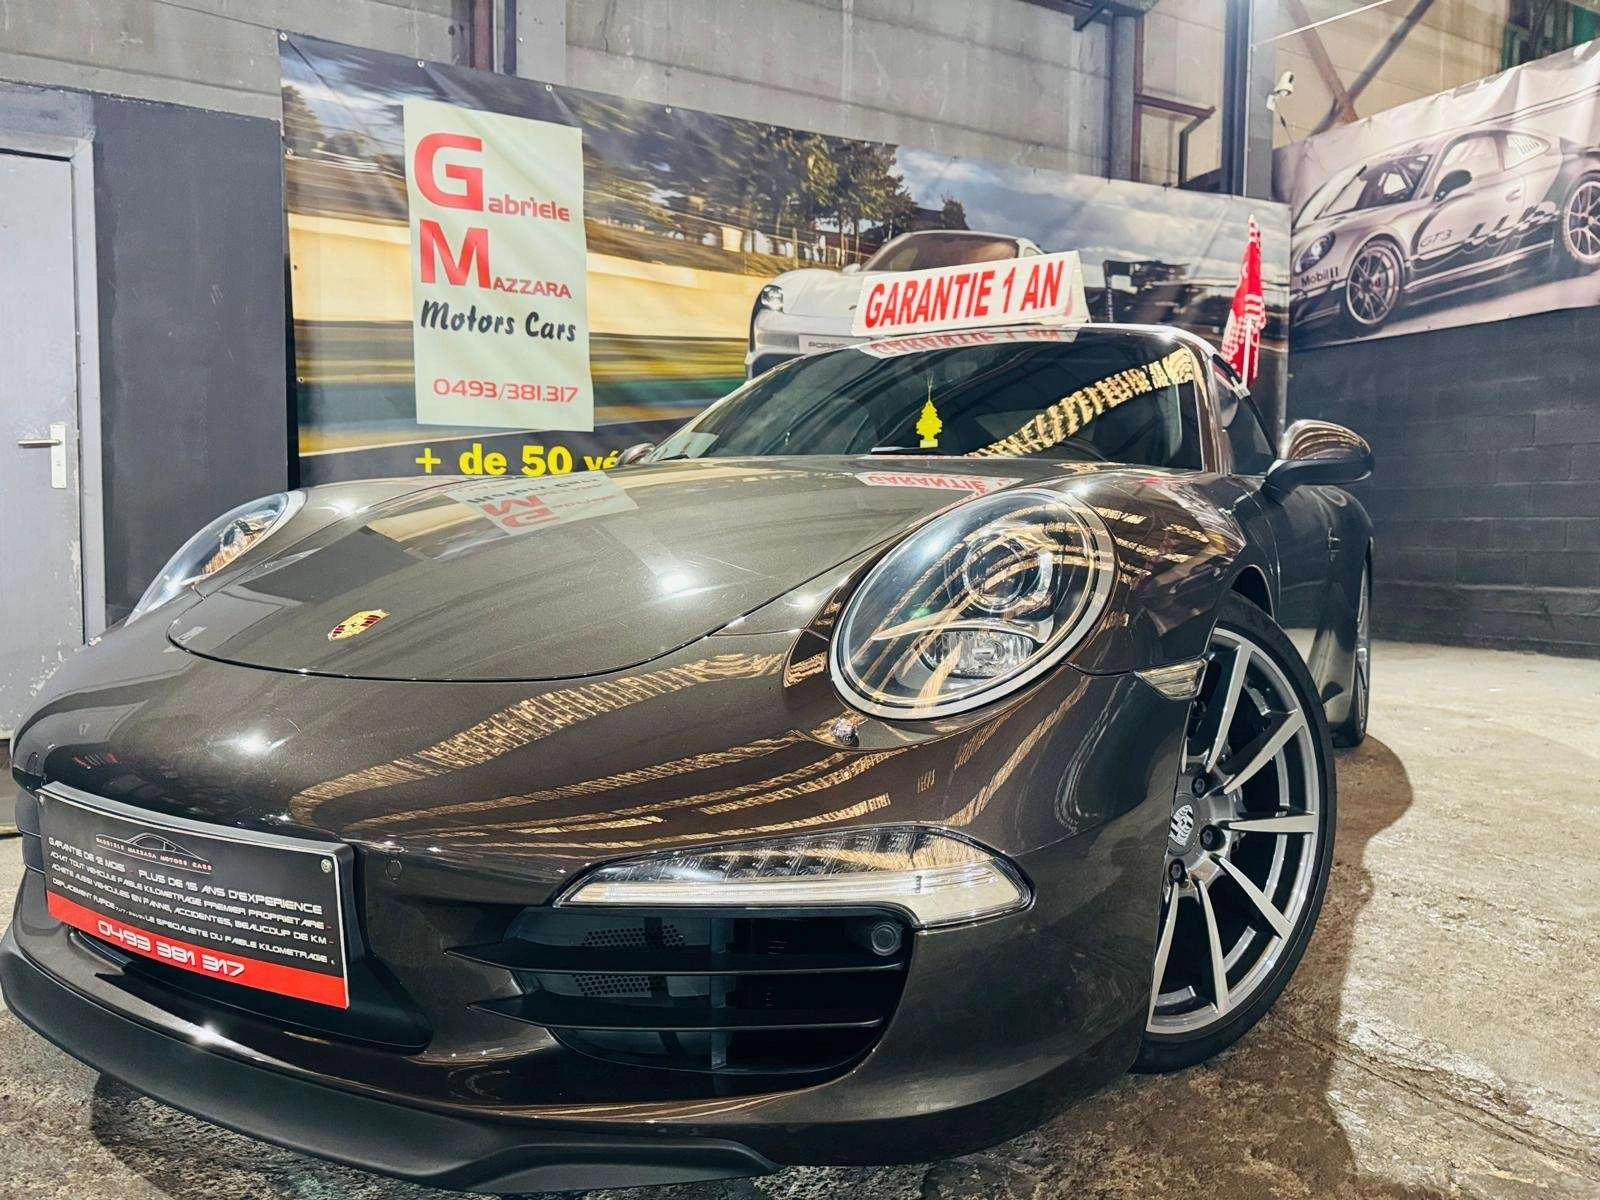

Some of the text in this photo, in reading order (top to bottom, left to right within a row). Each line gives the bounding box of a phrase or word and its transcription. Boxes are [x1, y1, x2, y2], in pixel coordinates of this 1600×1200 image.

[414, 132, 570, 222] Gabriele
[419, 218, 572, 299] MAZZARA
[1420, 229, 1452, 247] GT3
[421, 300, 576, 342] Motors Cars
[865, 270, 995, 328] GARANTIE
[1002, 273, 1015, 315] 1
[1024, 261, 1065, 313] AN
[433, 378, 578, 404] 0493/381.317
[415, 447, 442, 474] +
[459, 443, 507, 475] de
[521, 445, 573, 477] 50
[48, 837, 82, 858] GARANTIE
[83, 851, 95, 862] DE
[105, 858, 126, 873] MOIS
[138, 869, 166, 884] PLUS
[167, 876, 184, 888] DE
[186, 881, 198, 892] 15
[201, 885, 226, 897] ANS
[228, 889, 323, 915] D'EXPERIENCE
[68, 858, 85, 870] TOUT
[144, 885, 202, 907] KILOMETRAGE
[204, 900, 246, 916] PREMIER
[131, 893, 142, 903] EN
[234, 920, 291, 937] BEAUCOUP
[294, 931, 309, 941] DE
[311, 935, 327, 945] KM
[98, 919, 245, 977] 0493 381 317
[210, 932, 223, 941] DU
[259, 942, 328, 963] KILOMETRAGE
